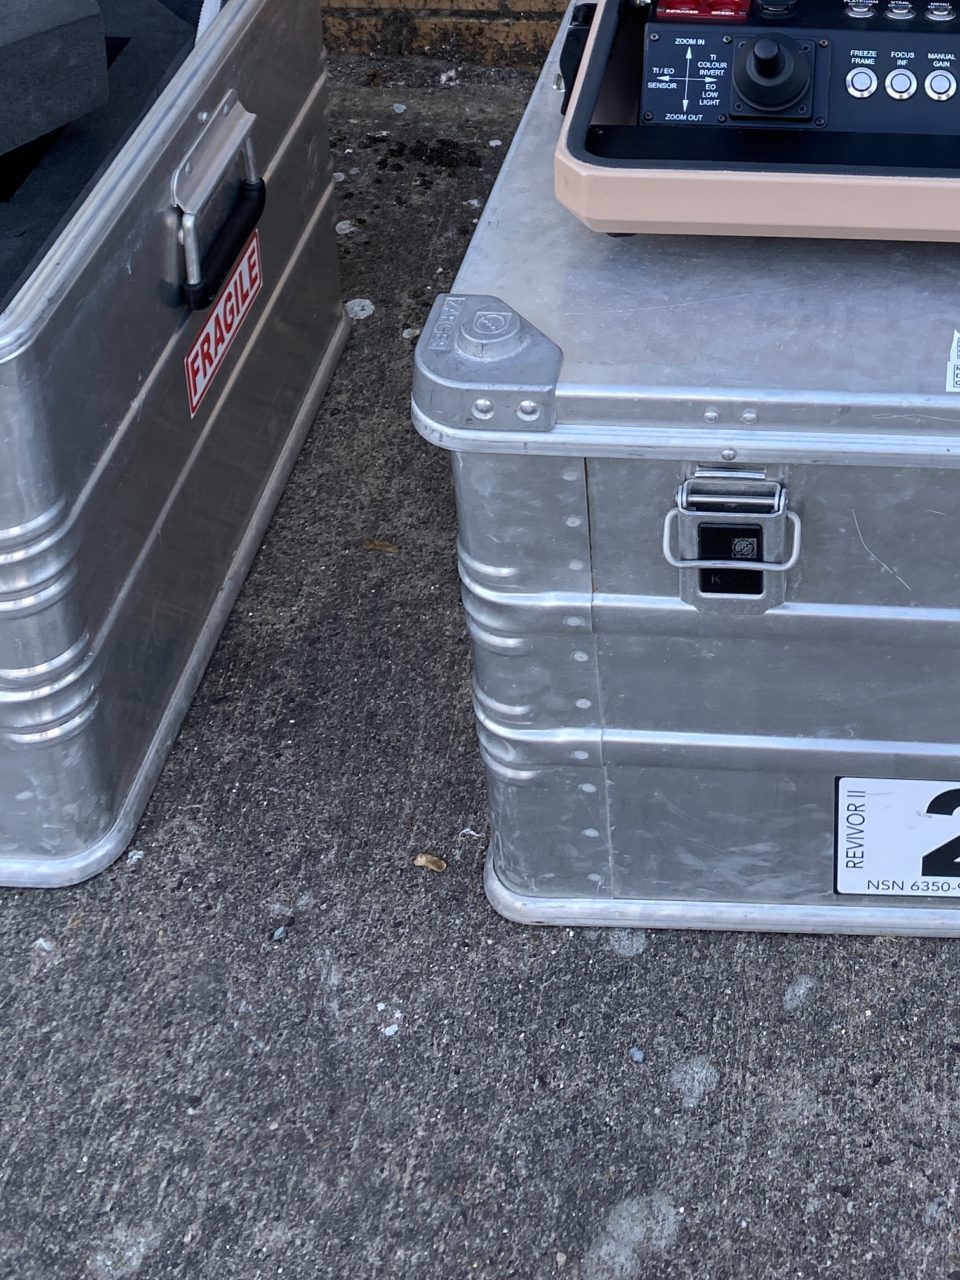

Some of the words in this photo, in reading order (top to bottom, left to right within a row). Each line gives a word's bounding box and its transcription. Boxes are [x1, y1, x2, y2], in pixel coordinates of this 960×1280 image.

[697, 38, 705, 46] IN
[850, 49, 878, 57] FREEZE
[890, 51, 915, 59] FOCUS
[927, 52, 957, 61] MANUAL
[697, 61, 728, 69] COLOUR
[851, 57, 876, 65] FRAME
[896, 58, 909, 67] INF
[933, 60, 951, 68] GAIN
[705, 83, 717, 91] EO
[665, 113, 686, 121] ZOOM
[189, 248, 259, 398] FRAGILE
[846, 790, 866, 798] II
[845, 802, 866, 869] REVIVOR
[867, 880, 905, 891] NSN
